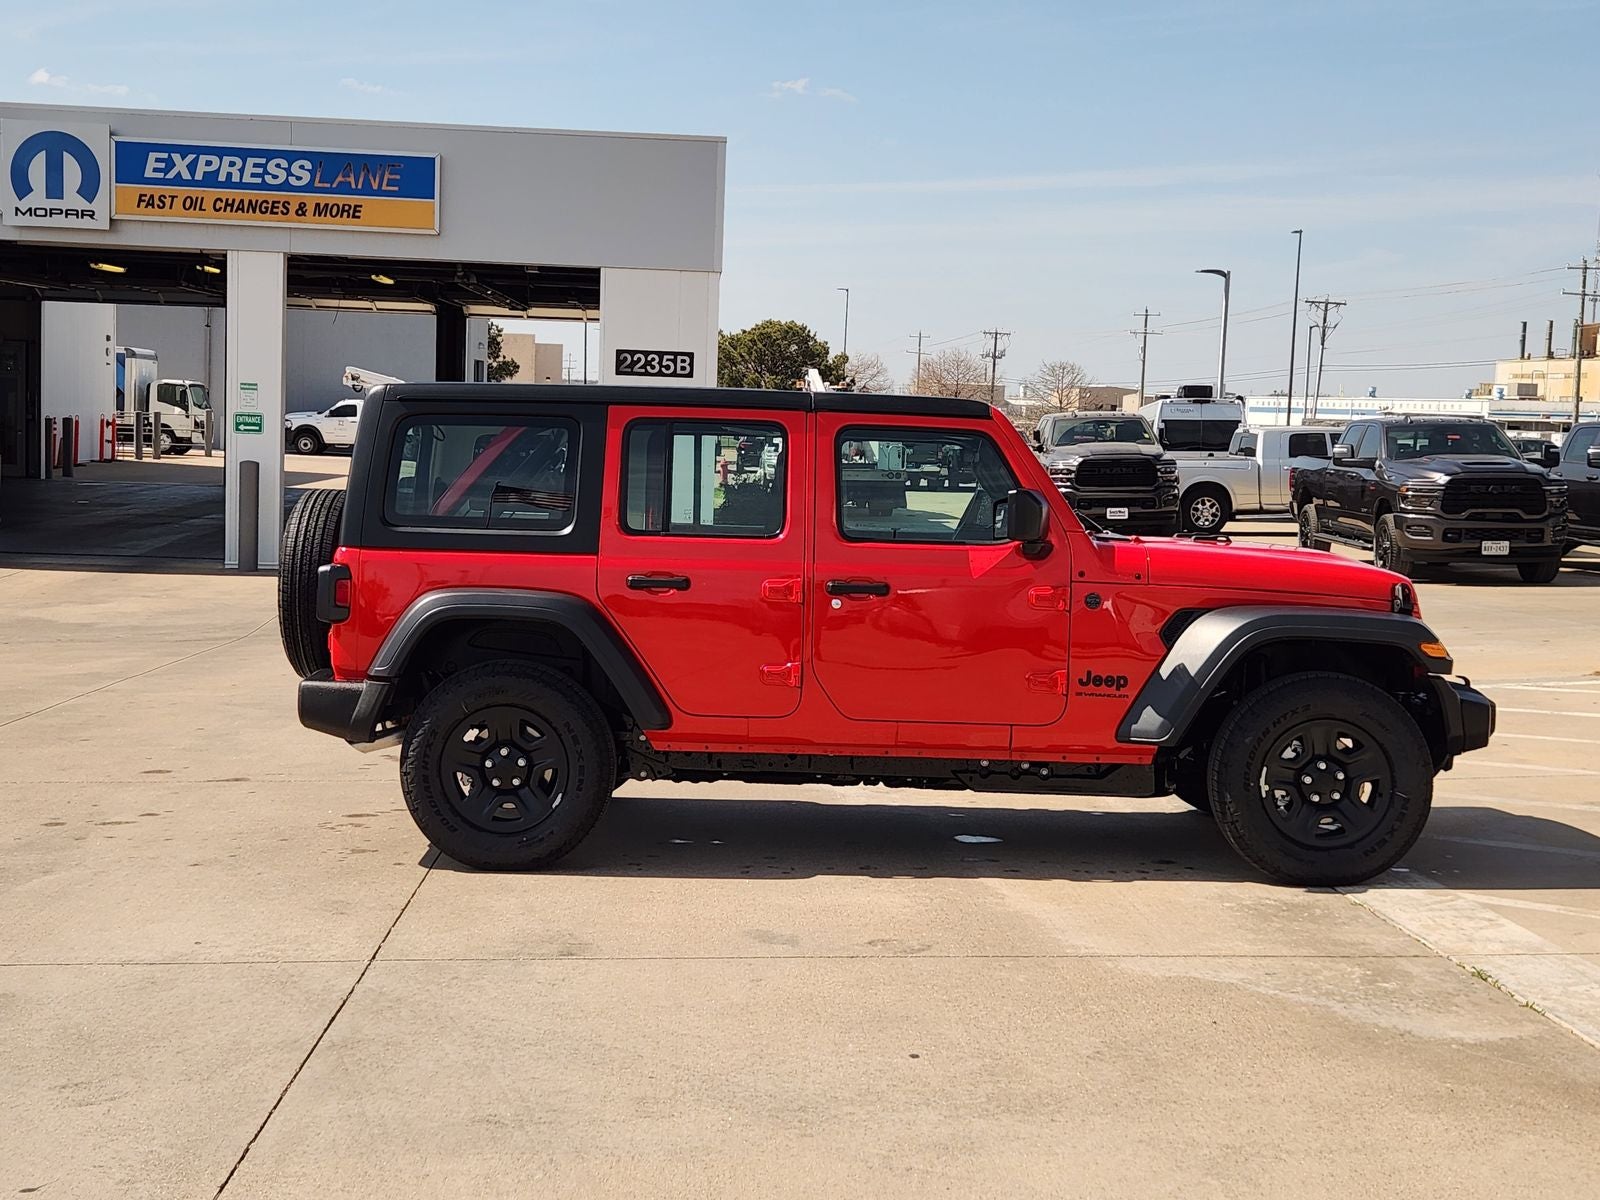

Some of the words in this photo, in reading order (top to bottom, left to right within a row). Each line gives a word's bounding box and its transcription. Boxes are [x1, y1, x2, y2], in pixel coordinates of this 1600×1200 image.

[14, 206, 96, 220] MOPAR
[136, 193, 178, 211] FAST
[182, 196, 208, 213] OIL
[212, 198, 290, 216] CHANGES
[294, 201, 308, 218] &
[313, 202, 363, 220] MORE
[618, 352, 691, 375] 2235B
[236, 415, 261, 424] ENTRANCE
[1078, 670, 1129, 691] Jeep
[563, 721, 587, 792] NEXEN
